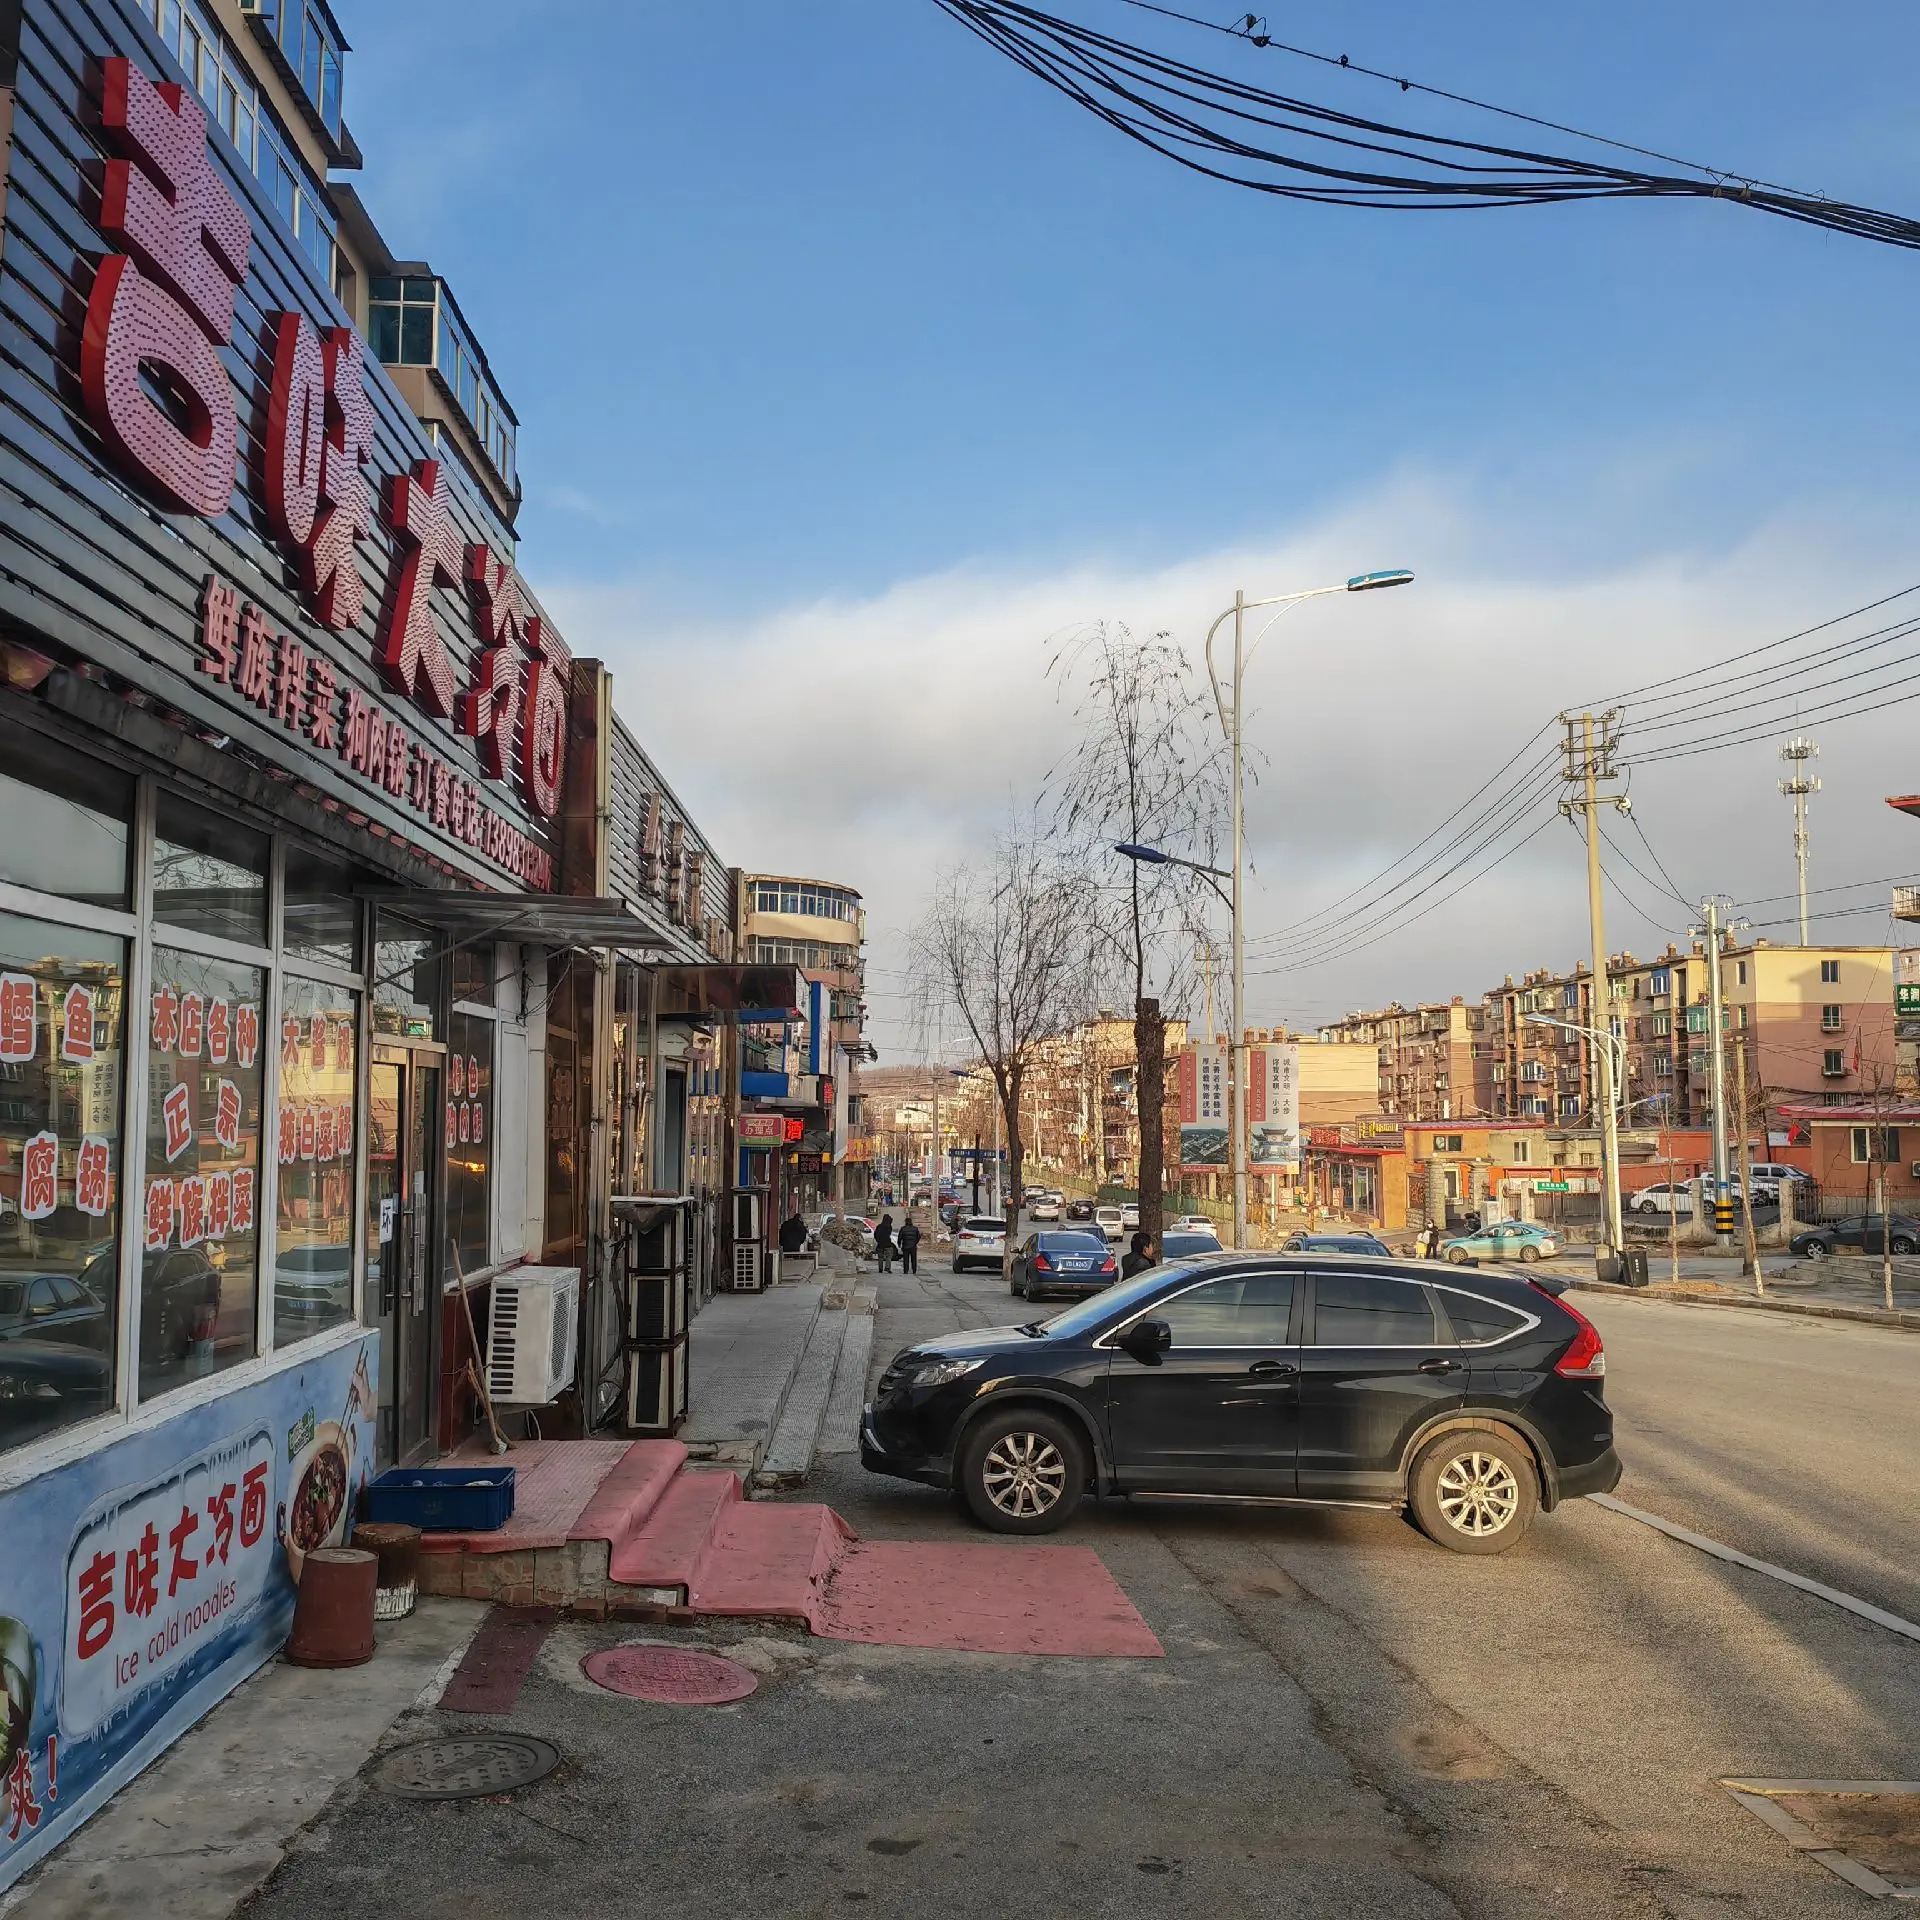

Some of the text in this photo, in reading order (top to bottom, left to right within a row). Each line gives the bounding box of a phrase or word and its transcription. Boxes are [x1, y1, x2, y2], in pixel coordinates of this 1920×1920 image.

[82, 57, 571, 817] 吉味大冷面
[200, 574, 338, 748] 鲜族拌菜
[340, 688, 408, 799] 狗肉锅
[0, 979, 95, 1058] 鳕鱼
[153, 987, 257, 1064] 本店各种
[283, 1016, 350, 1071] 大酱锅
[165, 1086, 240, 1157] 正宗
[280, 1104, 351, 1160] 辣白菜锅
[147, 1171, 252, 1246] 鲜族拌菜
[77, 1460, 268, 1660] 吉味大冷面
[116, 1578, 236, 1688] Ice cold noodles
